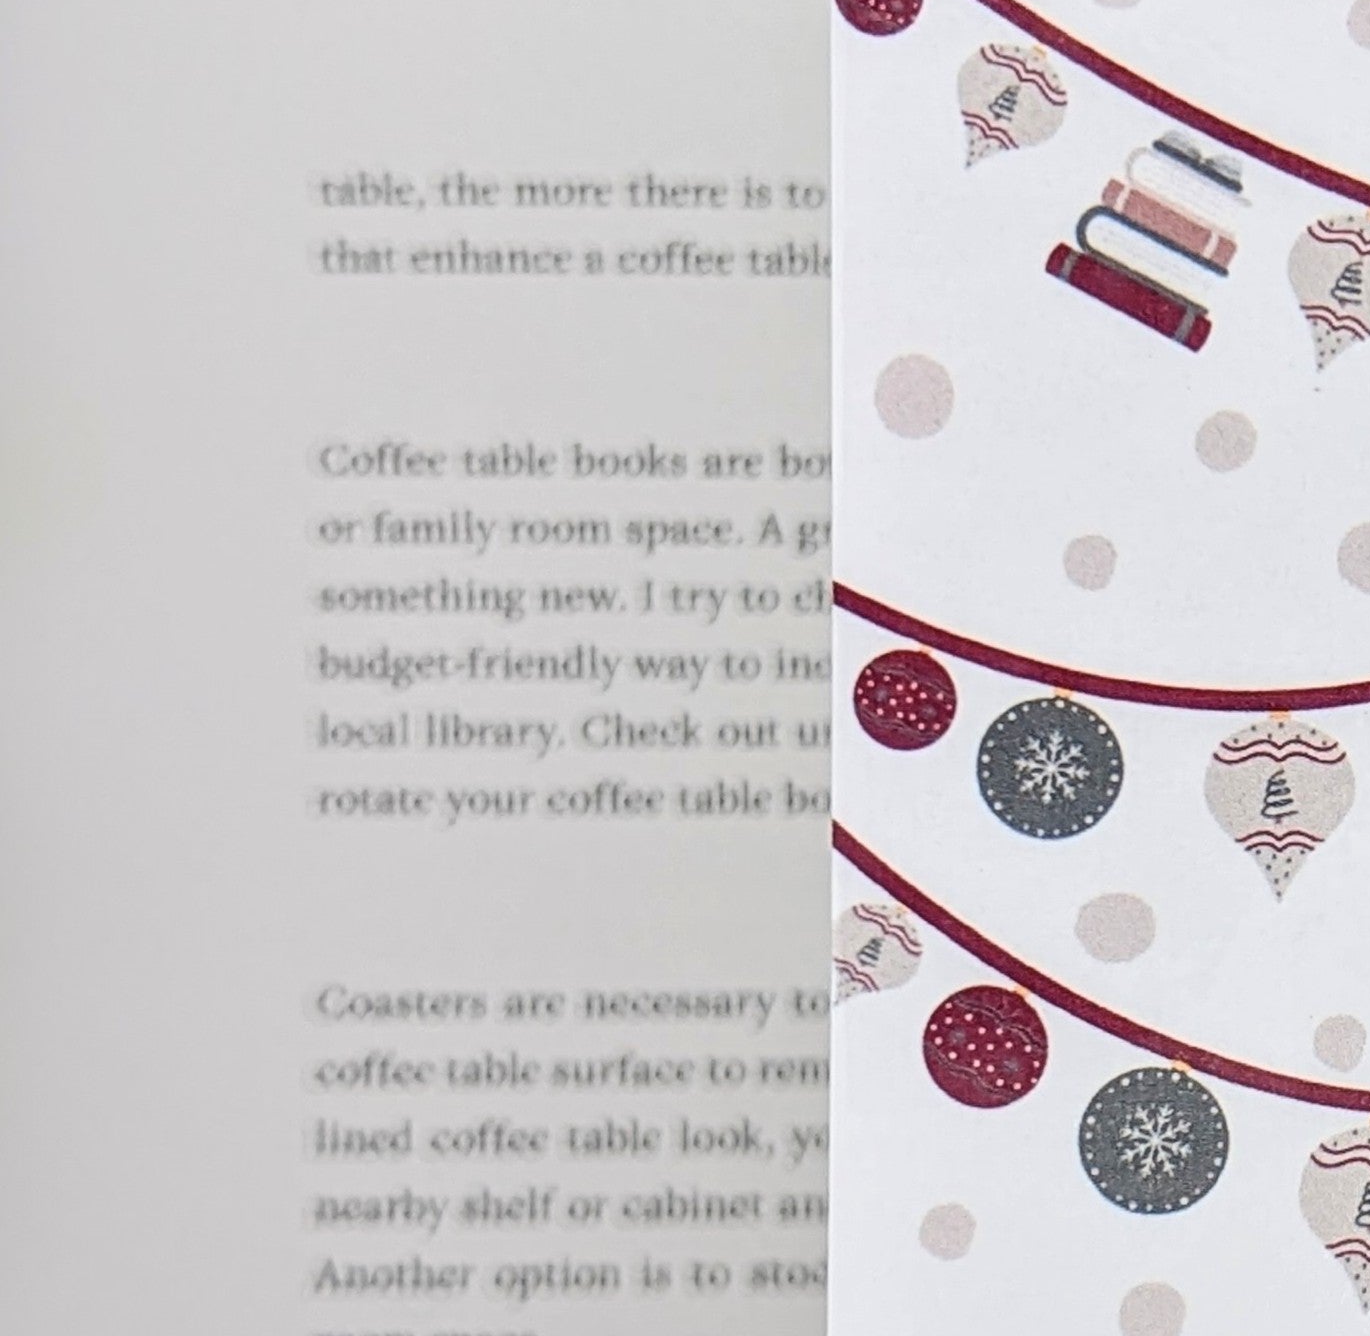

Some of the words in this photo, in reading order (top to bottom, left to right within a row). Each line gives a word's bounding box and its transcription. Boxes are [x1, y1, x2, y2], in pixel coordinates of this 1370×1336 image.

[437, 171, 500, 206] the
[514, 180, 613, 207] more
[625, 172, 728, 208] there
[742, 176, 772, 209] is
[782, 181, 828, 210] to
[321, 239, 393, 273] that
[411, 238, 566, 274] enhance
[585, 250, 603, 275] a
[618, 240, 732, 276] coffee
[319, 441, 447, 476] Coffee
[460, 442, 557, 477] table
[571, 443, 687, 477] books
[702, 453, 763, 479] are
[318, 519, 356, 543] or
[371, 510, 496, 555] family
[509, 519, 611, 545] room
[757, 513, 784, 546] A
[318, 578, 527, 623] something
[640, 579, 654, 612] I
[666, 584, 728, 624] try
[737, 584, 781, 613] to
[317, 644, 621, 691] budget-friendly
[632, 654, 710, 692] way
[718, 651, 762, 681] to
[316, 712, 409, 748] local
[580, 712, 701, 749] Check
[715, 718, 779, 749] out
[317, 788, 433, 816] rotate
[446, 790, 531, 825] your
[546, 779, 664, 815] coffee
[675, 779, 772, 816] table
[315, 987, 487, 1021] Coasters
[502, 992, 565, 1020] are
[579, 990, 776, 1029] necessary
[314, 1052, 434, 1088] coffee
[446, 1051, 540, 1088] table
[549, 1052, 695, 1088] surface
[704, 1056, 749, 1086] to
[315, 1119, 412, 1156] lined
[430, 1118, 547, 1157] coffee
[565, 1118, 660, 1157] table
[314, 1189, 447, 1238] nearby
[459, 1187, 553, 1226] shelf
[567, 1196, 604, 1224] or
[620, 1186, 764, 1225] cabinet
[315, 1258, 473, 1294] Another
[495, 1258, 620, 1303] option
[640, 1257, 670, 1293] is
[690, 1261, 730, 1293] to
